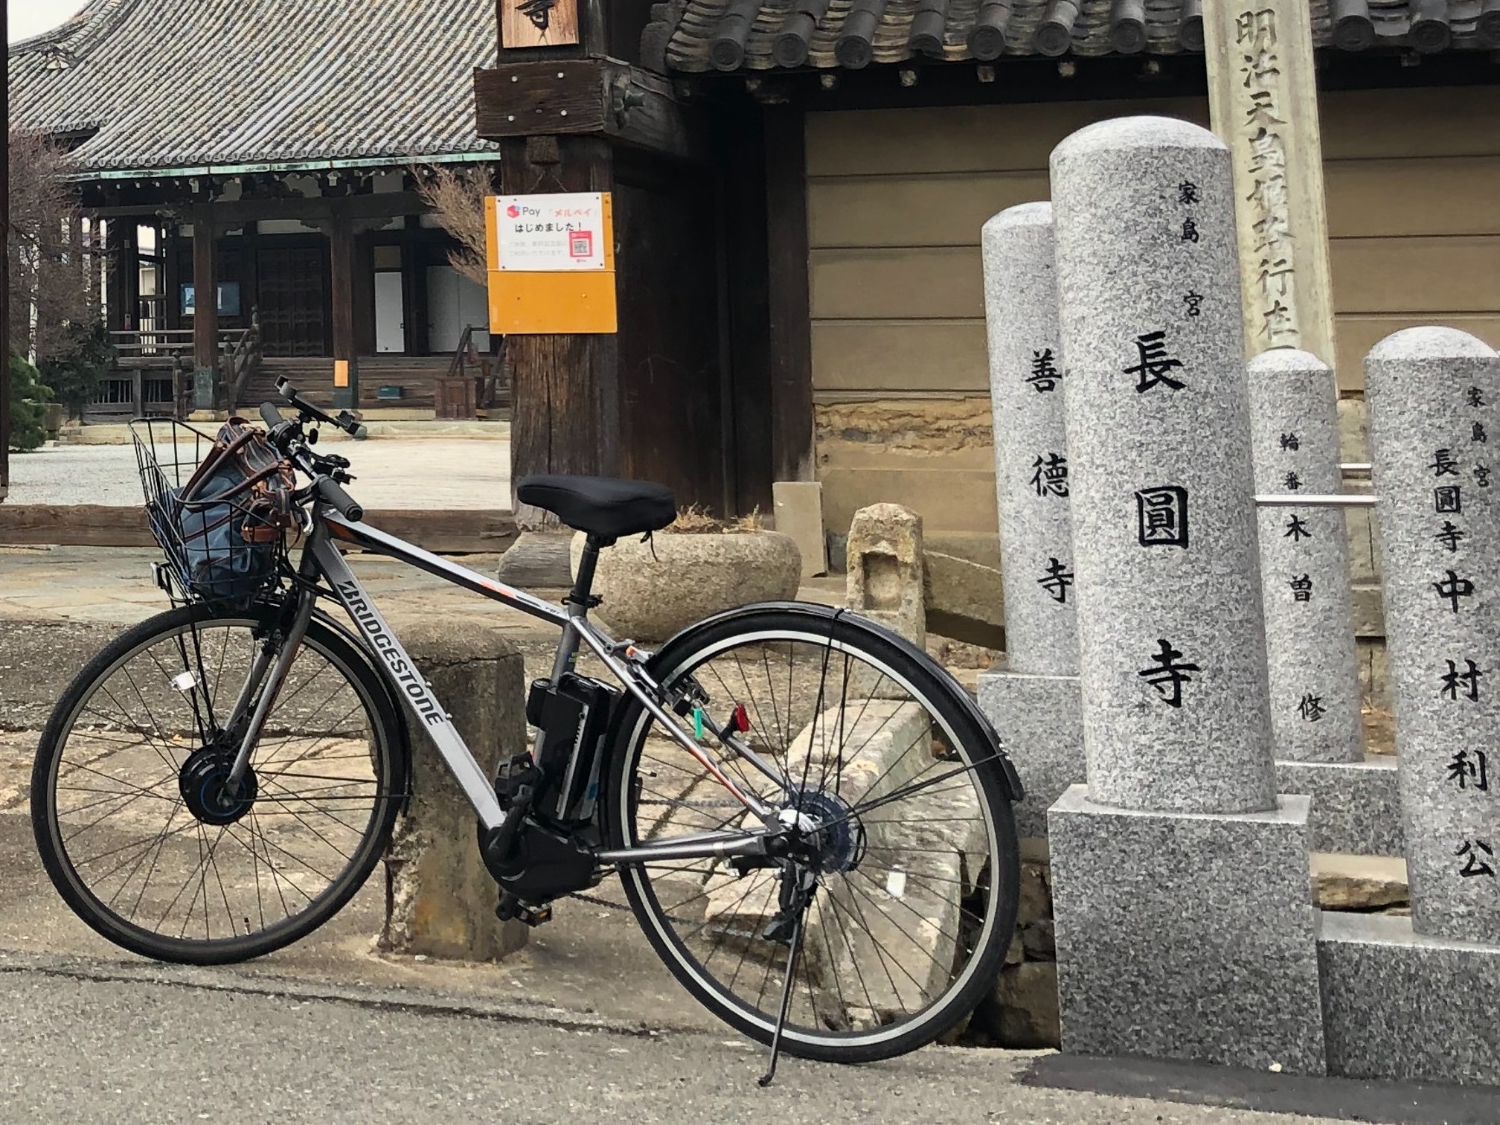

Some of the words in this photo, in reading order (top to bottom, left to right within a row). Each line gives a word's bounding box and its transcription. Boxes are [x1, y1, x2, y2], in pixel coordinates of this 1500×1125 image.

[522, 206, 541, 217] Pay
[1124, 330, 1200, 708] 長圓寺
[336, 580, 444, 726] BRIDGESTONE
